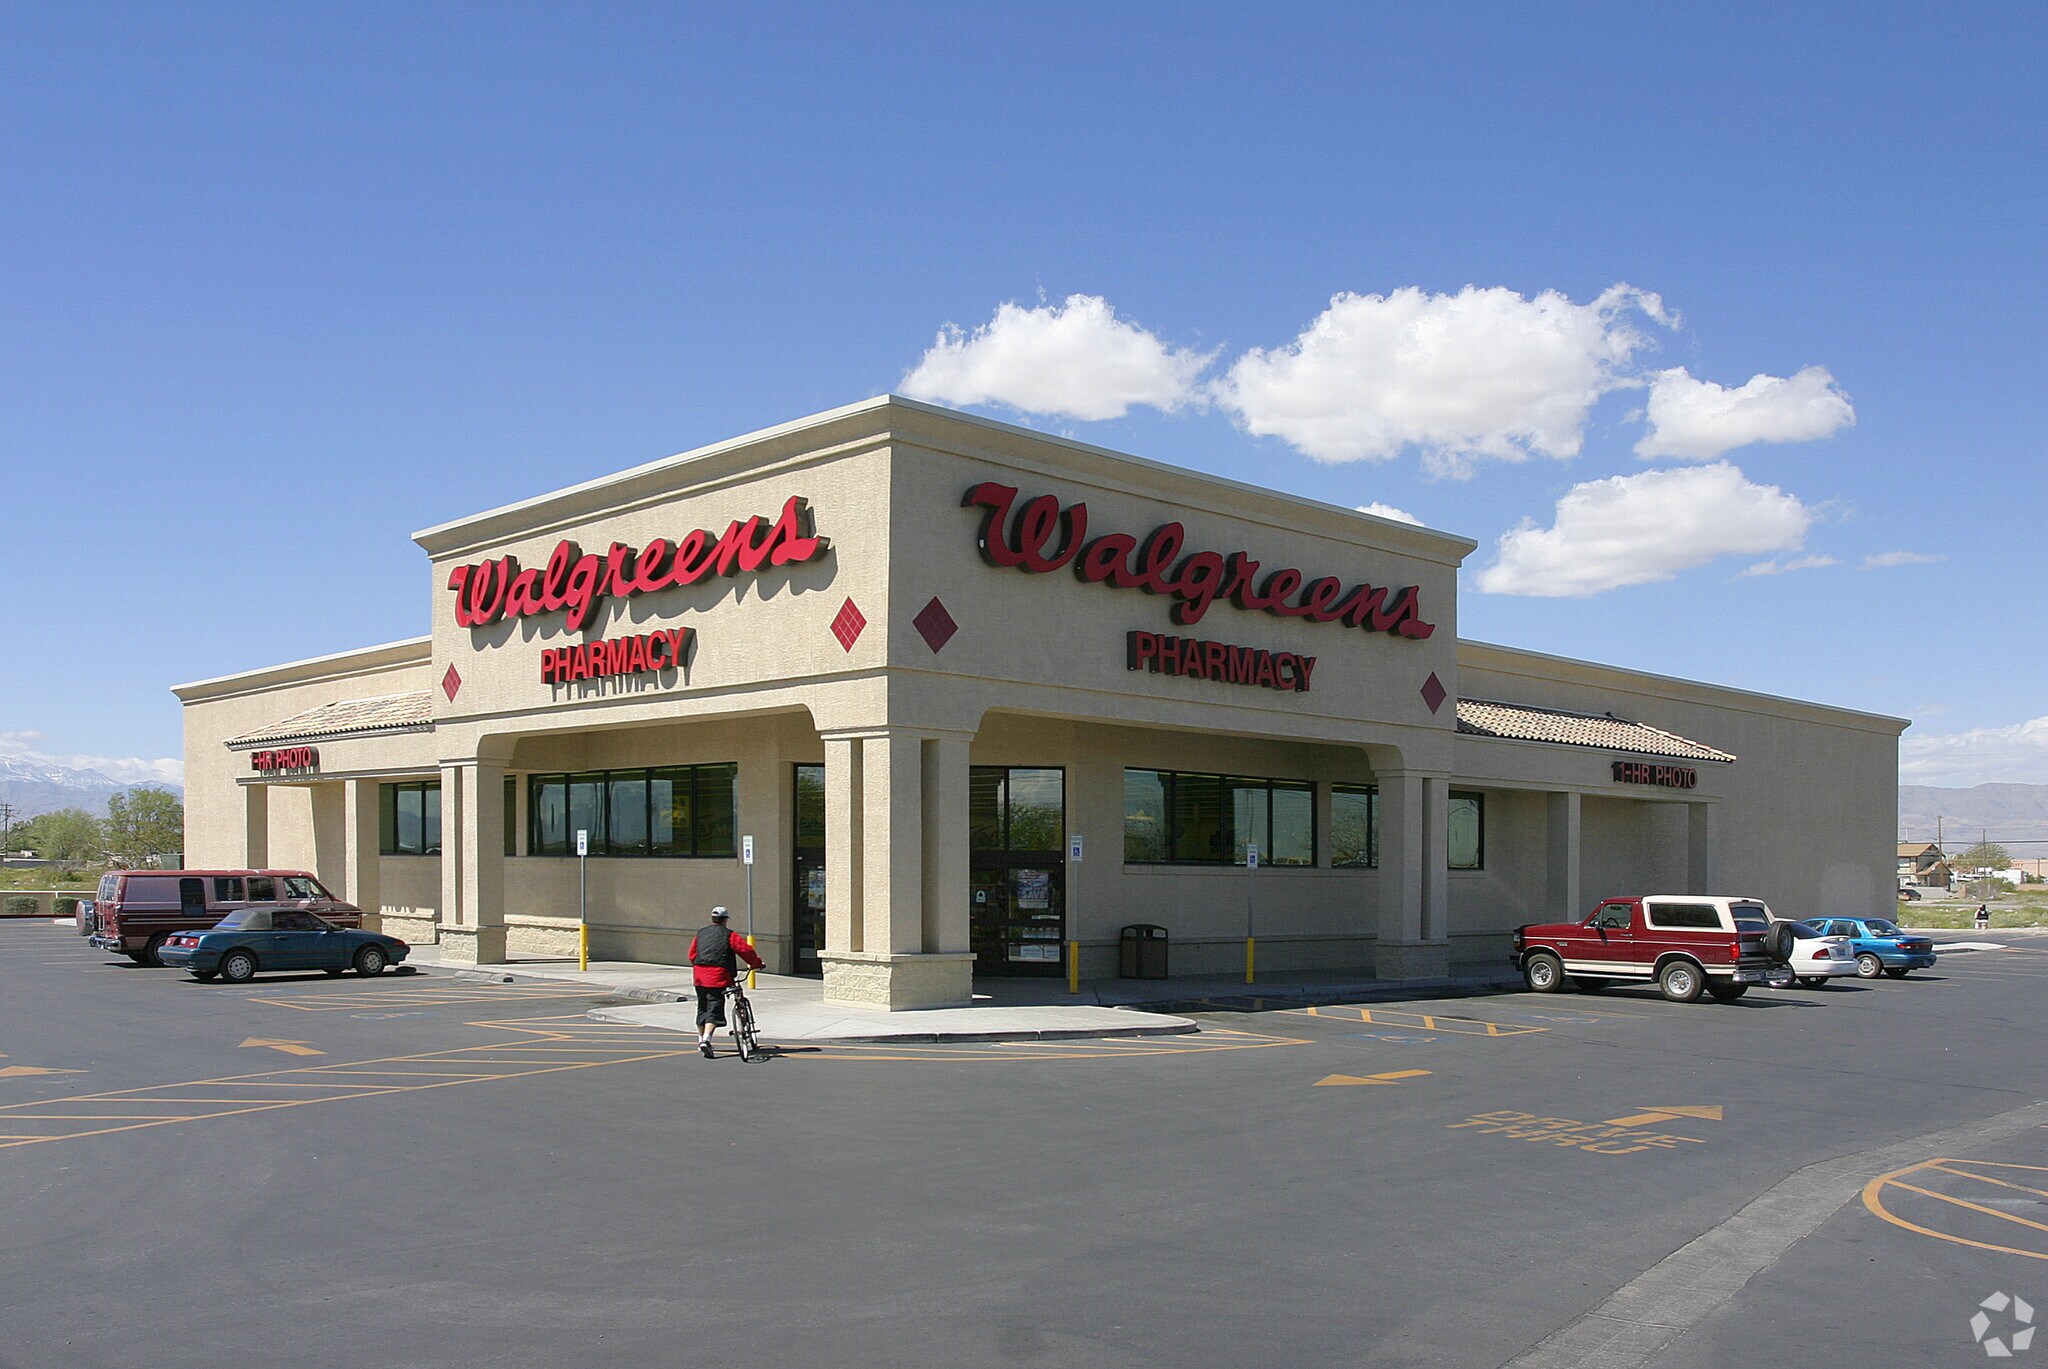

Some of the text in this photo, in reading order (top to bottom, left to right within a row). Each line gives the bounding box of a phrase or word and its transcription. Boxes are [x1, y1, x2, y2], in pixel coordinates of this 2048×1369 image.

[448, 495, 828, 632] Walgreens
[961, 481, 1436, 640] Walgreens
[541, 627, 692, 684] PHARMACY
[1129, 630, 1317, 692] PHARMACY
[276, 746, 311, 768] PHOTO
[1618, 762, 1697, 788] 1-HR PHOTO
